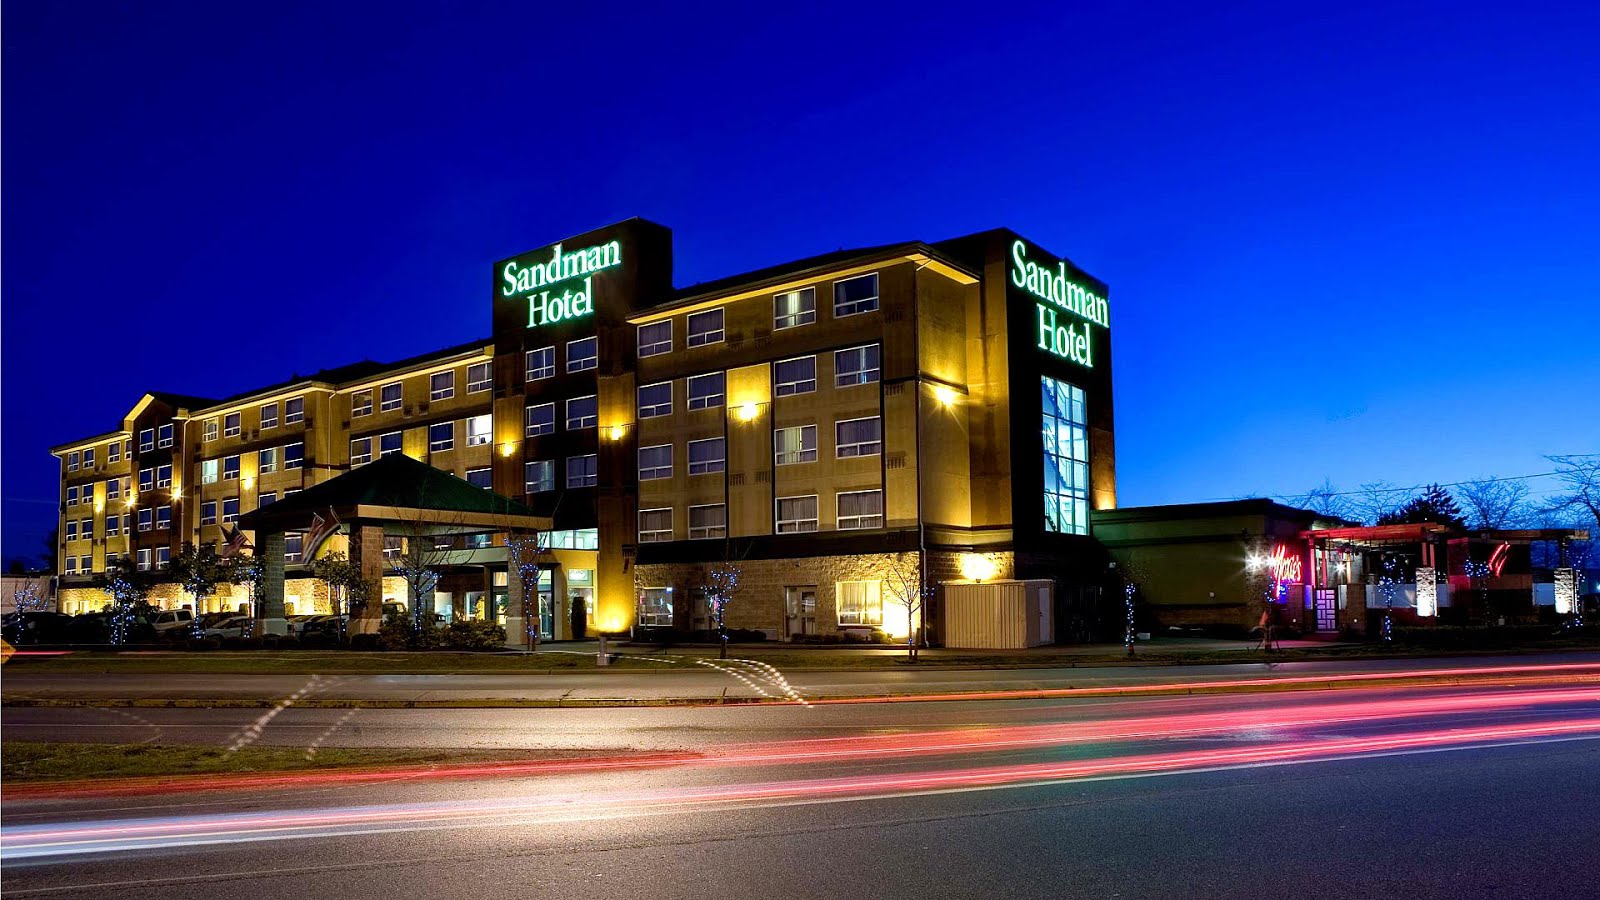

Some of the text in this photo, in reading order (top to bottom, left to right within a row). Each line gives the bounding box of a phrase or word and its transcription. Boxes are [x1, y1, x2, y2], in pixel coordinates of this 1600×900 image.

[503, 240, 621, 296] Sandman
[1012, 240, 1110, 328] Sandman
[526, 276, 594, 328] Hotel
[1036, 303, 1093, 367] Hotel
